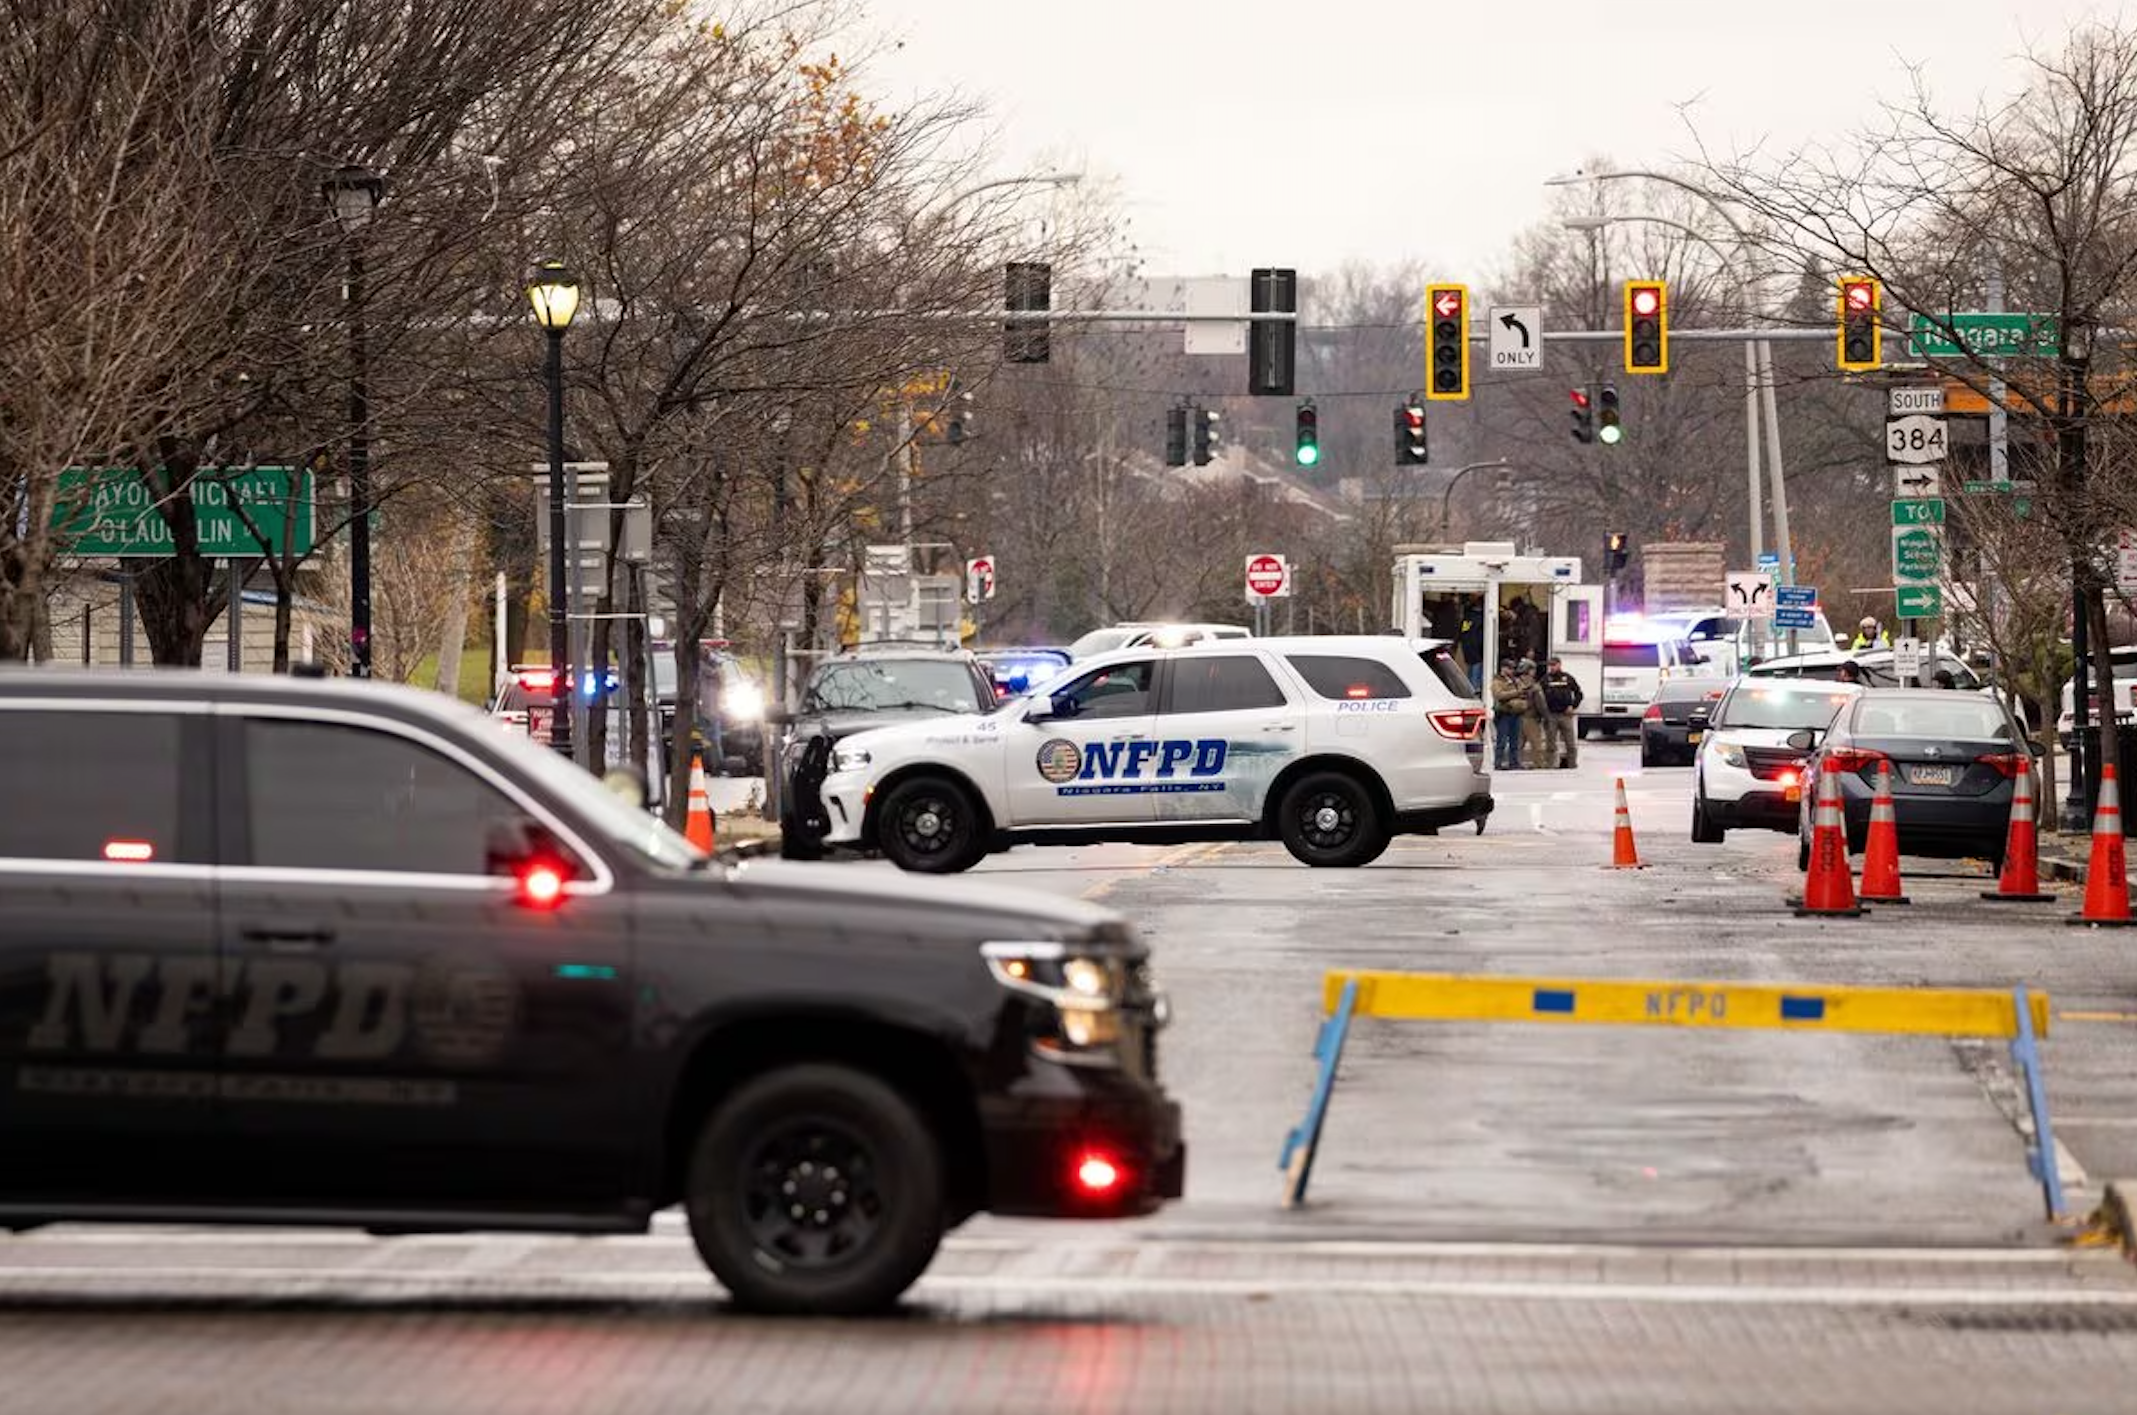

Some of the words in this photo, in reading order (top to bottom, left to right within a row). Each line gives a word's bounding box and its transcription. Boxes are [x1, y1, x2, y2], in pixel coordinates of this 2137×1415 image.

[1925, 322, 2024, 353] Nagara
[1497, 352, 1535, 364] ONLY
[1894, 393, 1940, 408] SOUTH
[1892, 428, 1944, 451] 384
[1905, 504, 1930, 520] TO
[101, 518, 232, 543] O'LAULIN
[1338, 701, 1399, 712] POLICE
[977, 722, 997, 732] 45
[1079, 739, 1229, 780] NFPD
[26, 950, 415, 1060] NFPD
